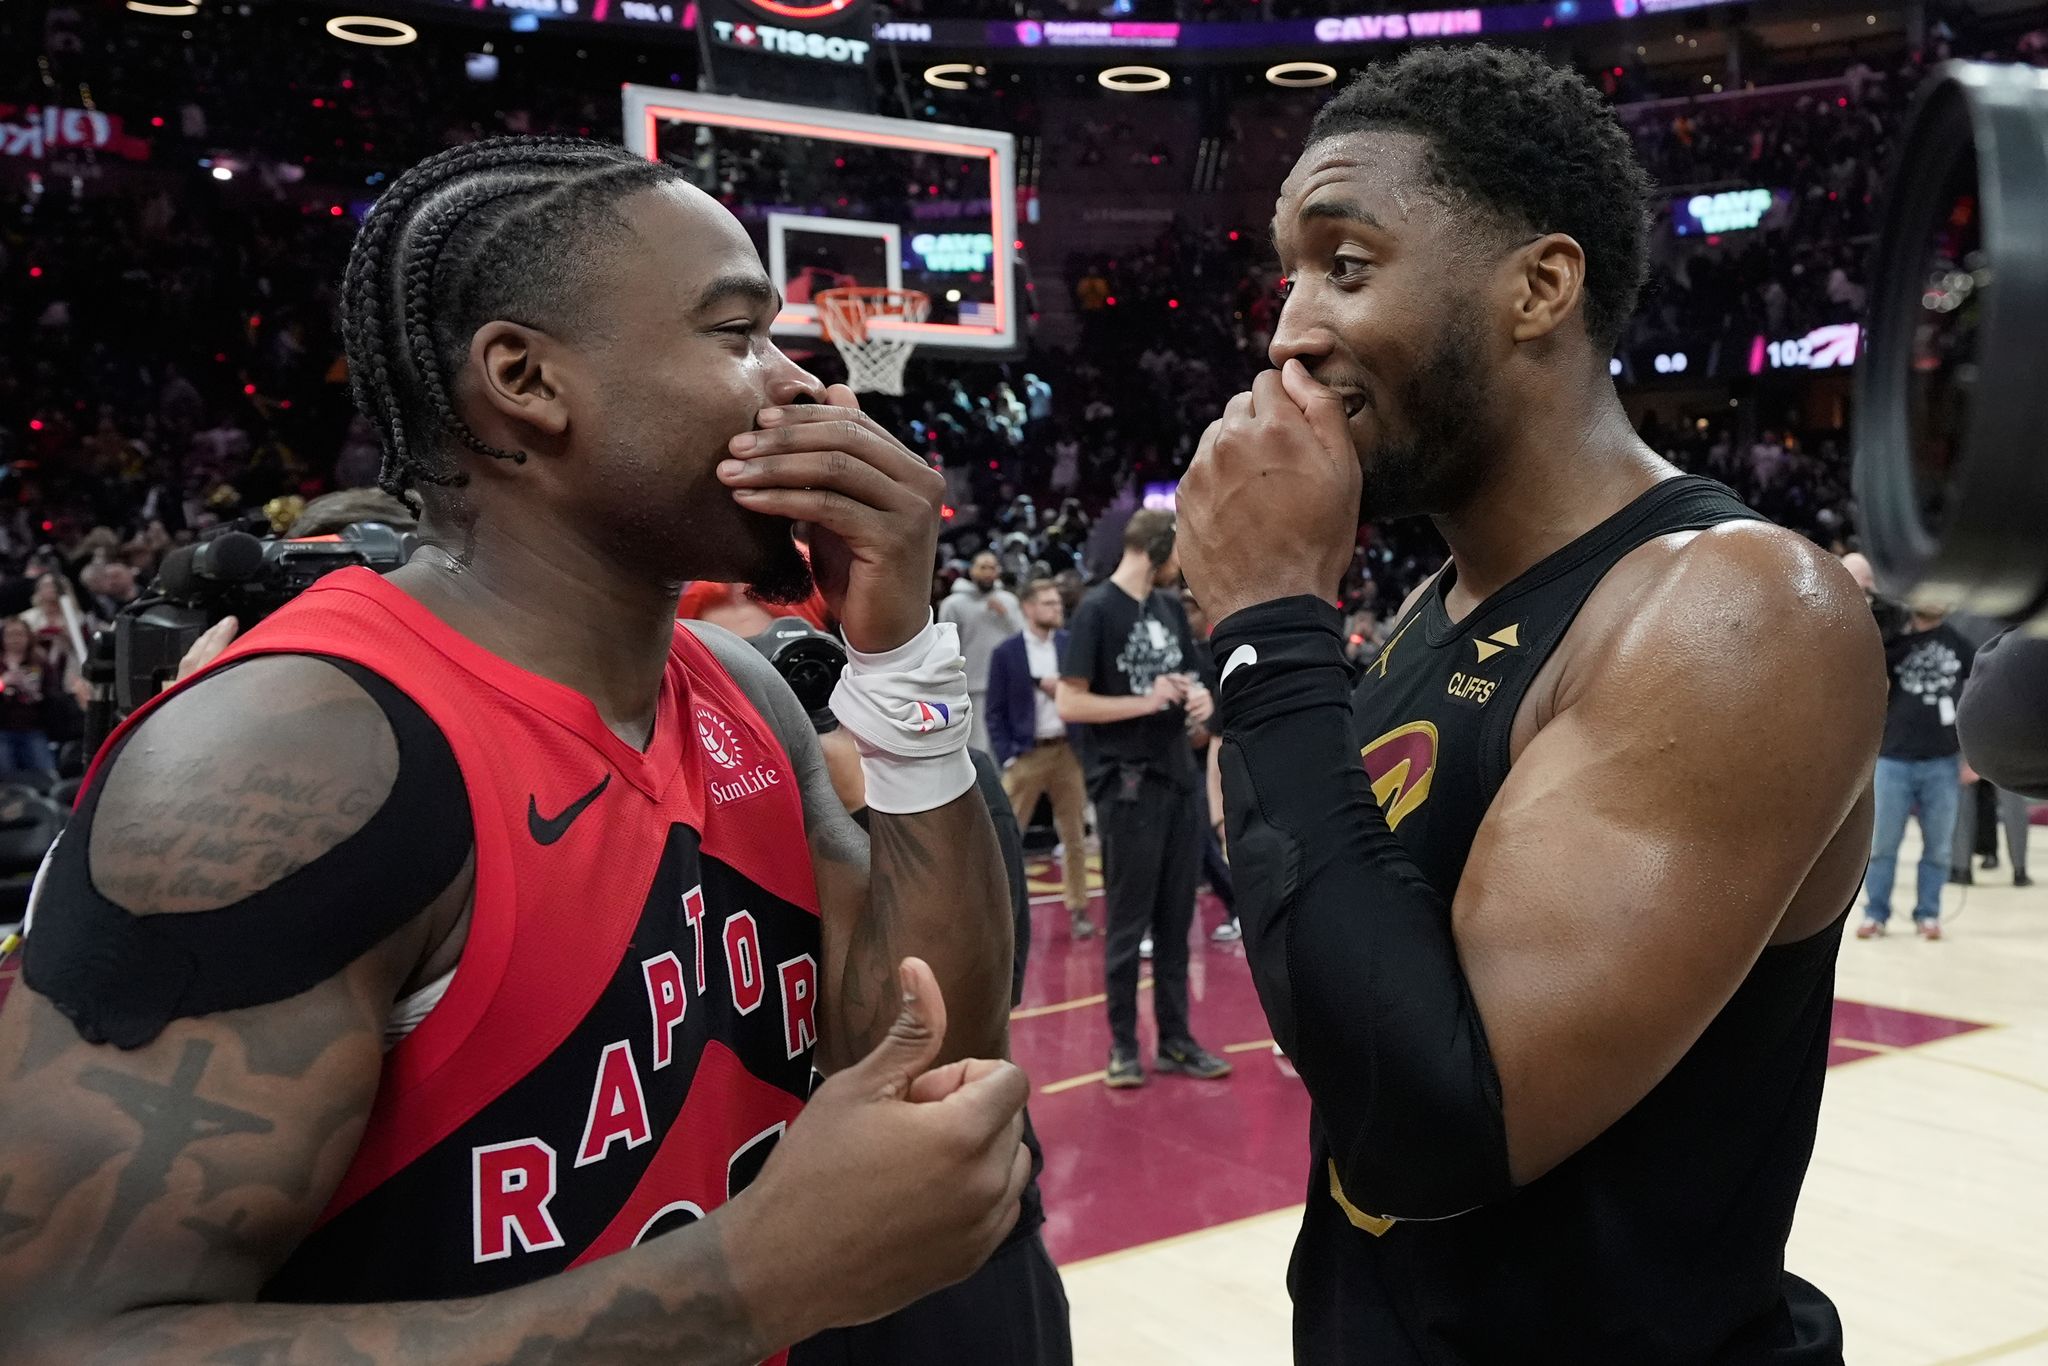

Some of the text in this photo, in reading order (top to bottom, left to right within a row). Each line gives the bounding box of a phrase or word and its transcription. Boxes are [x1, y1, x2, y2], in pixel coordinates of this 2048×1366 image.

[1314, 9, 1482, 42] CAVS WIN
[756, 25, 870, 65] TISSOT
[911, 233, 993, 255] CAVS
[1766, 336, 1813, 368] 102
[283, 543, 313, 551] SONY
[1447, 671, 1496, 704] CLIFFS
